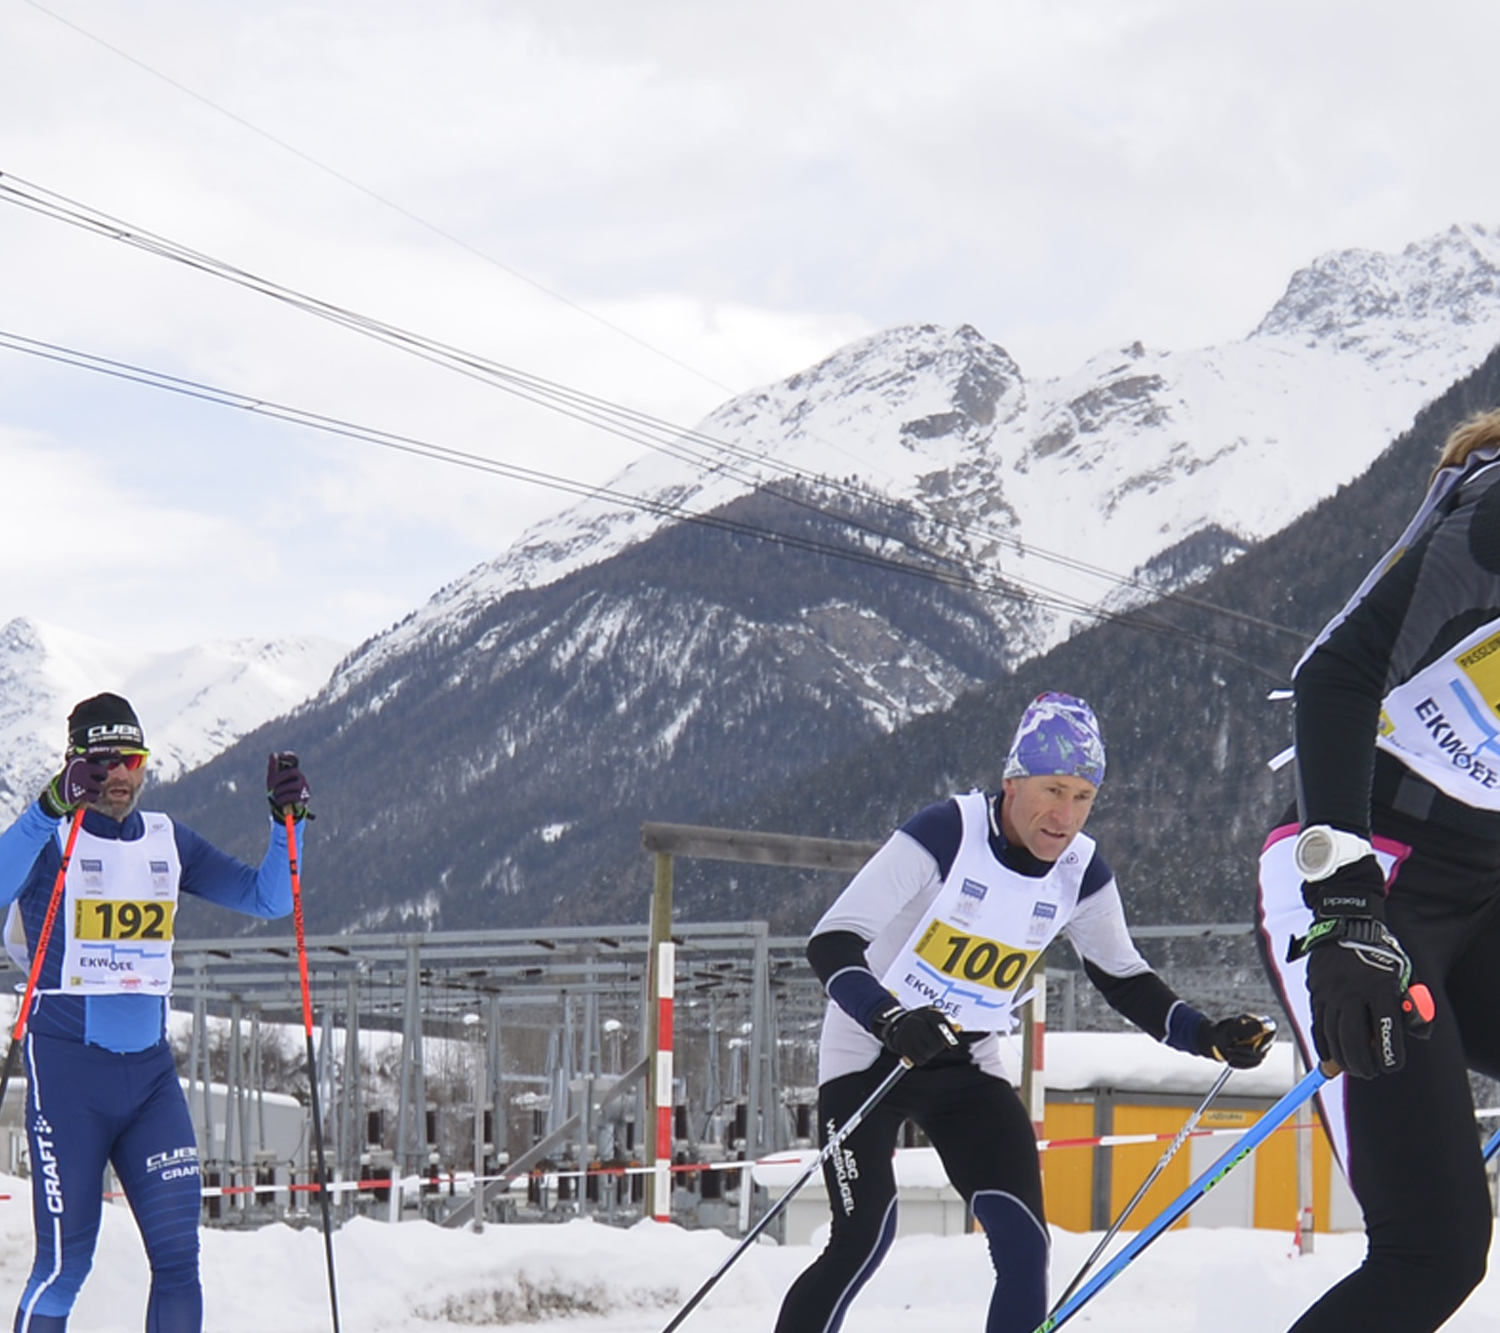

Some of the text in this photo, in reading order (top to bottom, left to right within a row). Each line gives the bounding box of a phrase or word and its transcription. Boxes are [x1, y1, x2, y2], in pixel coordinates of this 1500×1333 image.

[95, 903, 165, 939] 192
[941, 936, 1028, 989] 100
[36, 1134, 64, 1214] CRAFT
[843, 1148, 859, 1180] ASC
